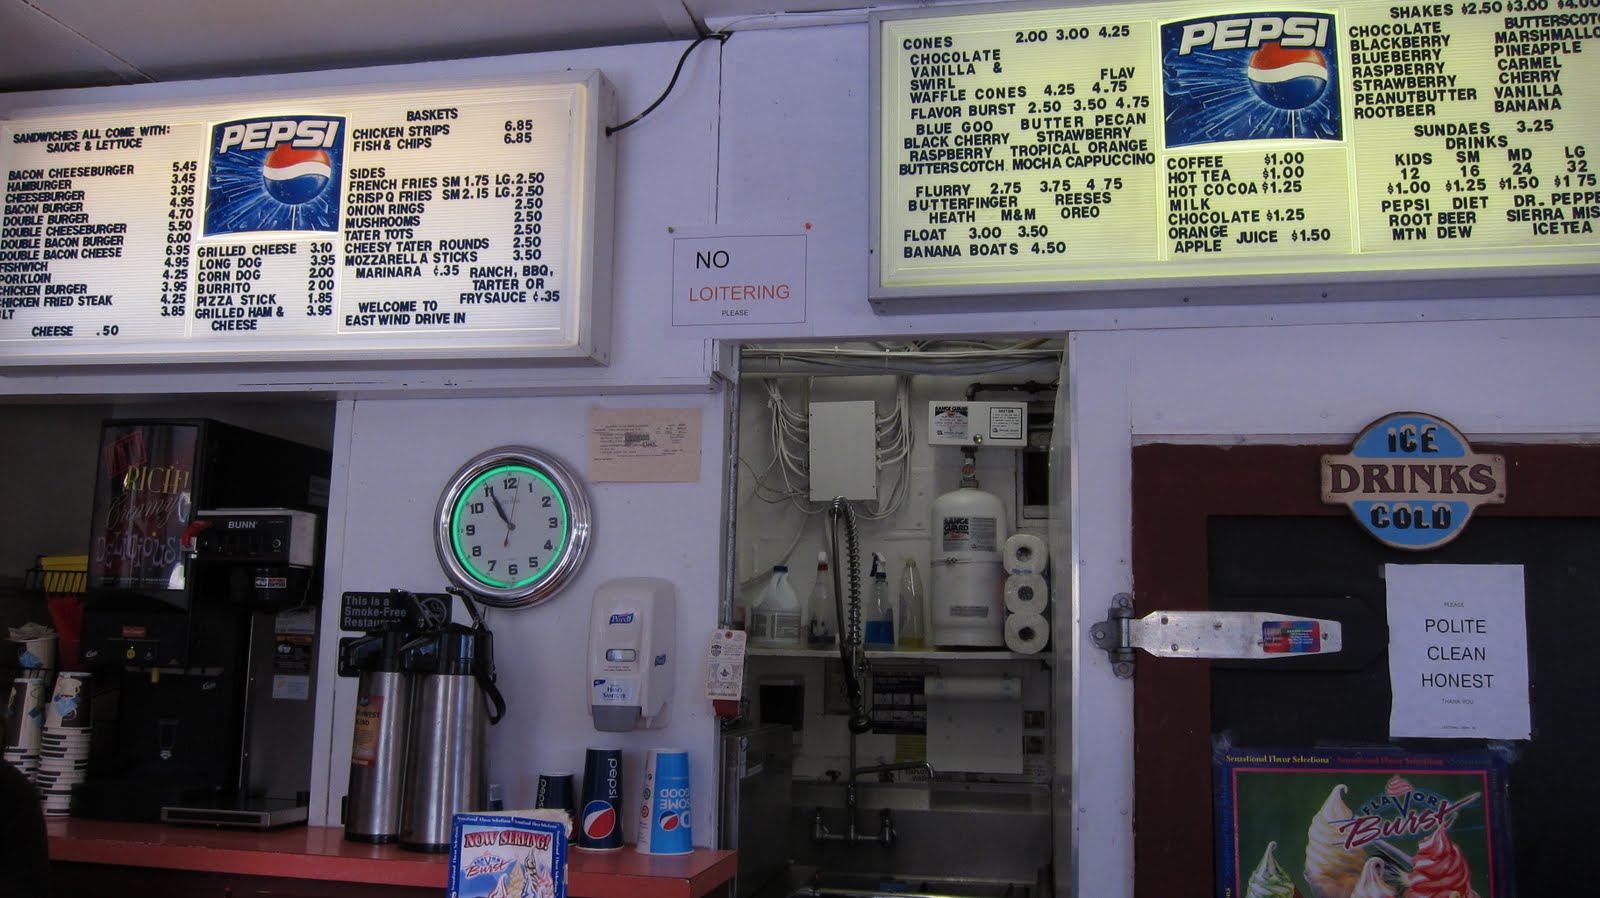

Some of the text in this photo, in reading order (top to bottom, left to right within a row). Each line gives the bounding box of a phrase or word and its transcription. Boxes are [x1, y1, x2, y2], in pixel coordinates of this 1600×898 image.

[1390, 2, 1502, 19] SHAKES $2.50
[903, 25, 1130, 50] CONES 2.00 3.00 4.25
[1179, 17, 1329, 55] PEPSI
[1350, 35, 1450, 51] BLACKBERRY
[910, 49, 1000, 65] CHOCOLATE
[1351, 42, 1582, 65] BLUEBERRY PINEAPPLE
[911, 62, 1002, 77] VANILLA &
[1100, 67, 1135, 80] FLAV
[1353, 57, 1562, 78] RASPBERRY CARMEL
[910, 78, 955, 90] SWIRL
[910, 81, 1127, 103] WAFFLE CONES 4.25 4.75
[407, 108, 458, 121] BASKETS
[911, 96, 1150, 119] FLAVOR BURST 2.50 3.50 4.75
[13, 125, 170, 143] SANDWICHES ALL COME WITH:
[353, 120, 533, 139] CHICKEN STRIPS 6.85
[1414, 119, 1554, 137] SUNDAES 3.25
[219, 120, 339, 154] PEPSI
[904, 127, 1132, 149] BLACK CHERRY STRAWBERRY
[1446, 136, 1508, 150] DRINKS
[47, 139, 142, 153] SAUCE & LETTUCE
[910, 140, 1147, 161] RASPBERRY TROPICAL ORANGE
[1167, 152, 1304, 170] COFFEE $1.00
[1395, 146, 1585, 166] KIDS SM MD LG
[8, 162, 197, 180] BACON CHEESEBURGER 5.45
[350, 168, 385, 179] SIDES
[7, 174, 196, 192] HAMBURGER 3.45
[5, 185, 195, 203] CHEESEBURGER 3.95
[347, 199, 543, 216] ONION RINGS 2.50
[1170, 198, 1210, 210] MILK
[346, 211, 542, 228] MUSHROOMS 2.50
[929, 206, 1100, 224] HEATH M&M OREO
[1168, 209, 1305, 225] CHOCOLATE $1.25
[2, 221, 192, 238] DOUBLE CHEESEBURGER 5.50
[345, 224, 541, 241] TATER TOTS 2.50
[904, 225, 1048, 241] FLOAT 3.00 3.50
[197, 243, 332, 258] GRILLED CHEESE 3.10
[904, 242, 1066, 258] BANANA BOATS 4.50
[1175, 240, 1222, 253] APPLE
[345, 250, 541, 266] MOZZARELLA STICKS 3.50
[696, 251, 729, 268] NO
[198, 268, 334, 282] CORN DOG 2.00
[197, 293, 332, 306] PIZZA STICK 1.85
[690, 285, 790, 301] LOITERING
[358, 301, 438, 313] WELCOME TO
[1388, 424, 1440, 453] ICE
[503, 478, 517, 489] 12
[1330, 464, 1496, 494] DRINKS
[528, 483, 532, 493] 1
[470, 503, 484, 514] 10
[542, 497, 551, 507] 2
[549, 518, 558, 528] 3
[1370, 502, 1452, 529] COLD
[228, 521, 256, 529] BUNN
[466, 525, 475, 536] 9
[472, 546, 481, 557] 8
[544, 540, 553, 550] 4
[488, 560, 497, 572] 7
[509, 564, 518, 575] 6
[529, 557, 538, 568] 5
[345, 595, 368, 605] This
[371, 596, 380, 605] is
[344, 607, 406, 616] Smoke-Free
[1425, 619, 1486, 634] POLITE
[1427, 647, 1486, 660] CLEAN
[1422, 674, 1494, 688] HONEST
[607, 758, 618, 799] pepsi
[538, 779, 546, 807] peps
[1362, 792, 1437, 816] FLAVOR
[1340, 801, 1482, 849] Burst
[464, 830, 551, 850] NOW SERVING!
